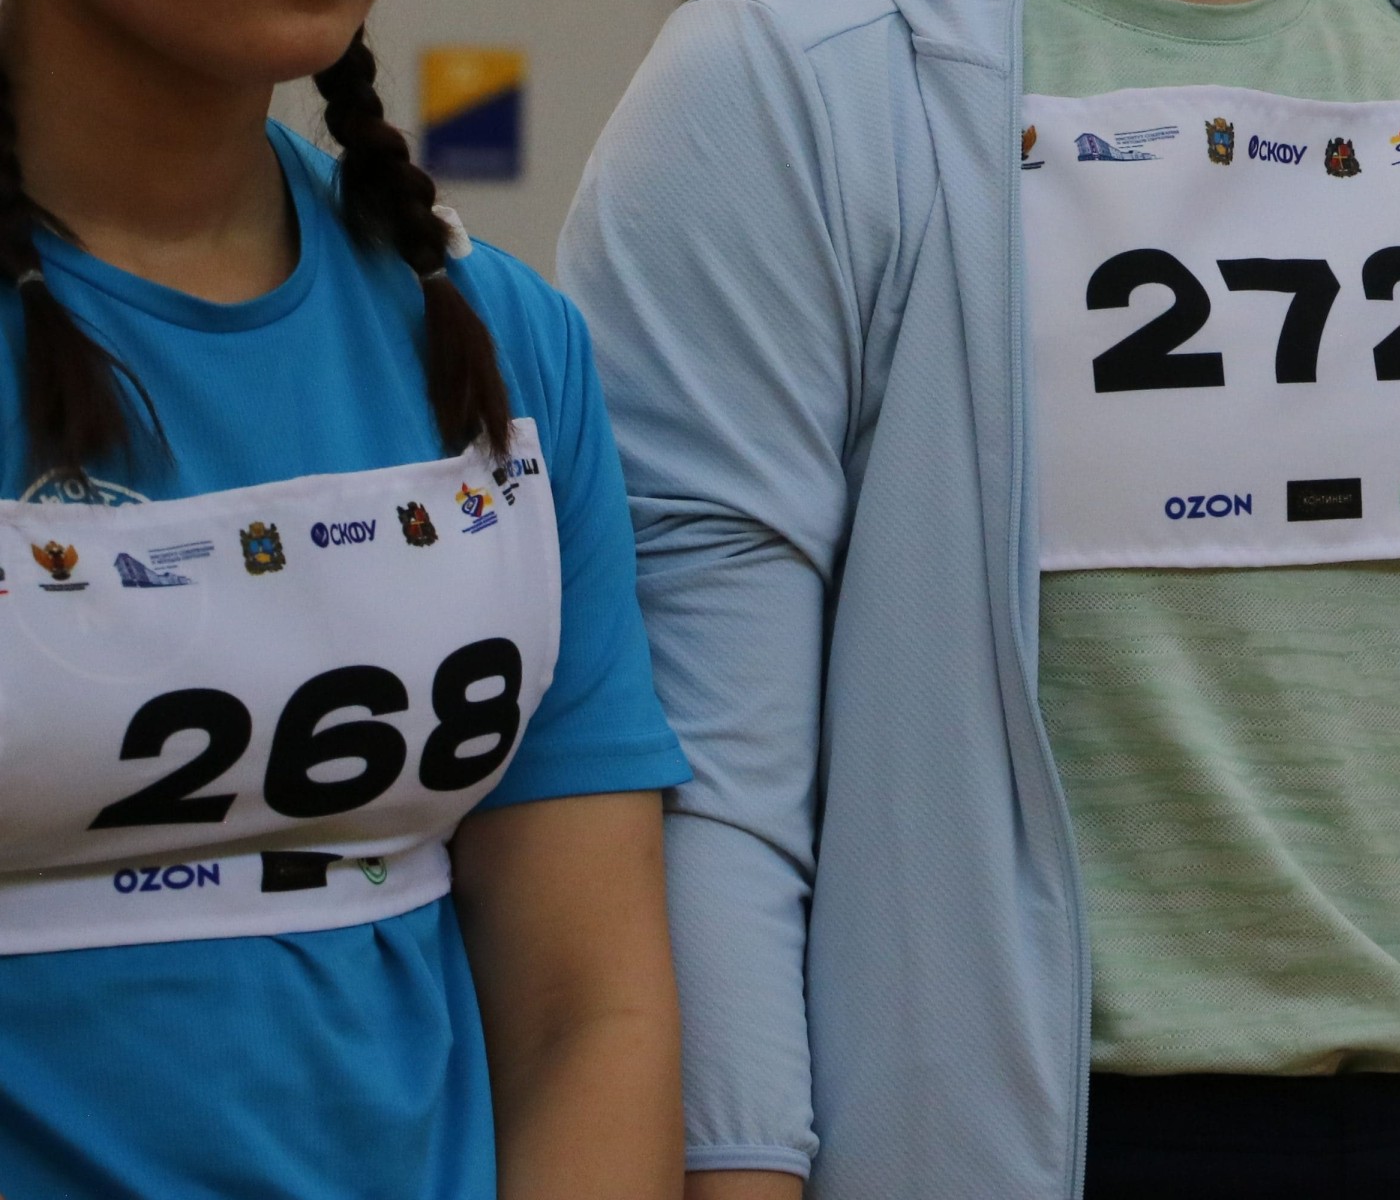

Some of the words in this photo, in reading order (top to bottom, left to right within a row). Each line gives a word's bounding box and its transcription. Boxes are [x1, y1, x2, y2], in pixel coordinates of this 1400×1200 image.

[1258, 139, 1308, 166] СКФУ
[1164, 492, 1253, 521] OZON
[329, 519, 377, 546] СКФУ
[87, 637, 523, 831] 268
[113, 862, 221, 895] OZON
